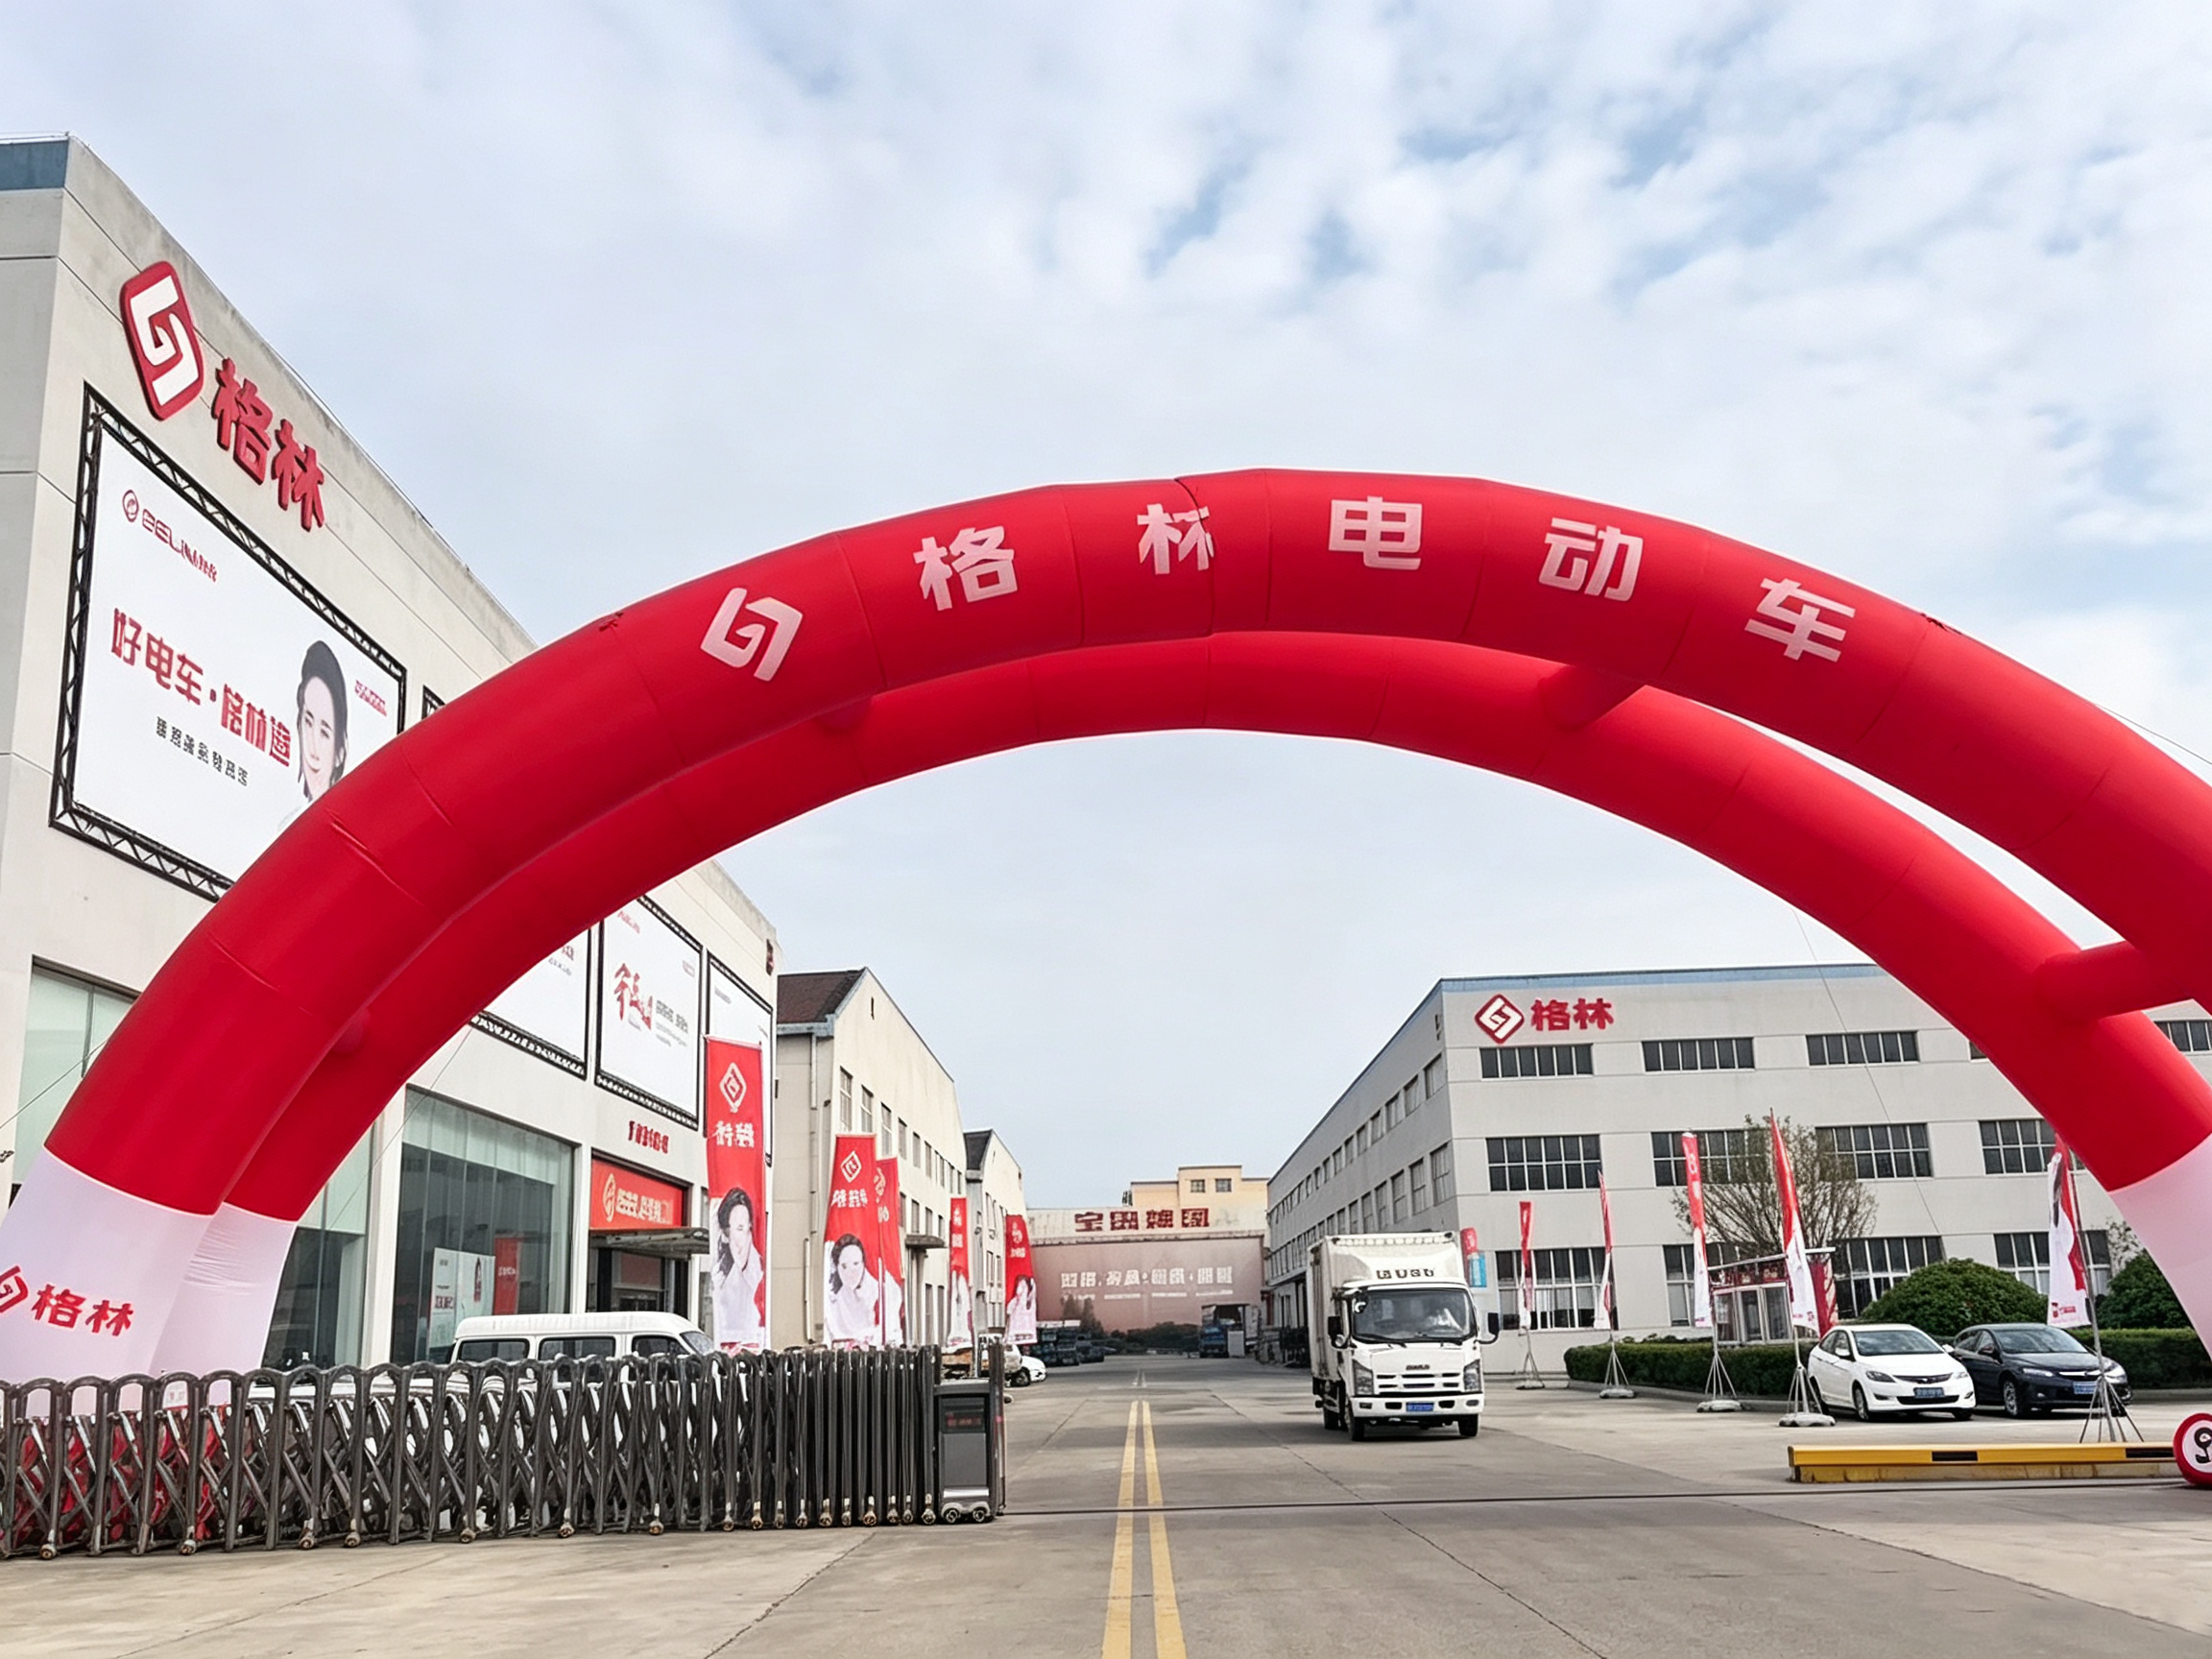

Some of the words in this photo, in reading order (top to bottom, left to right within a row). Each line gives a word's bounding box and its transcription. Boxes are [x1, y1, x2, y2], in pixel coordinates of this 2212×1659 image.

[210, 357, 325, 533] 格林
[1530, 998, 1614, 1032] 格林
[31, 1284, 133, 1336] 格林
